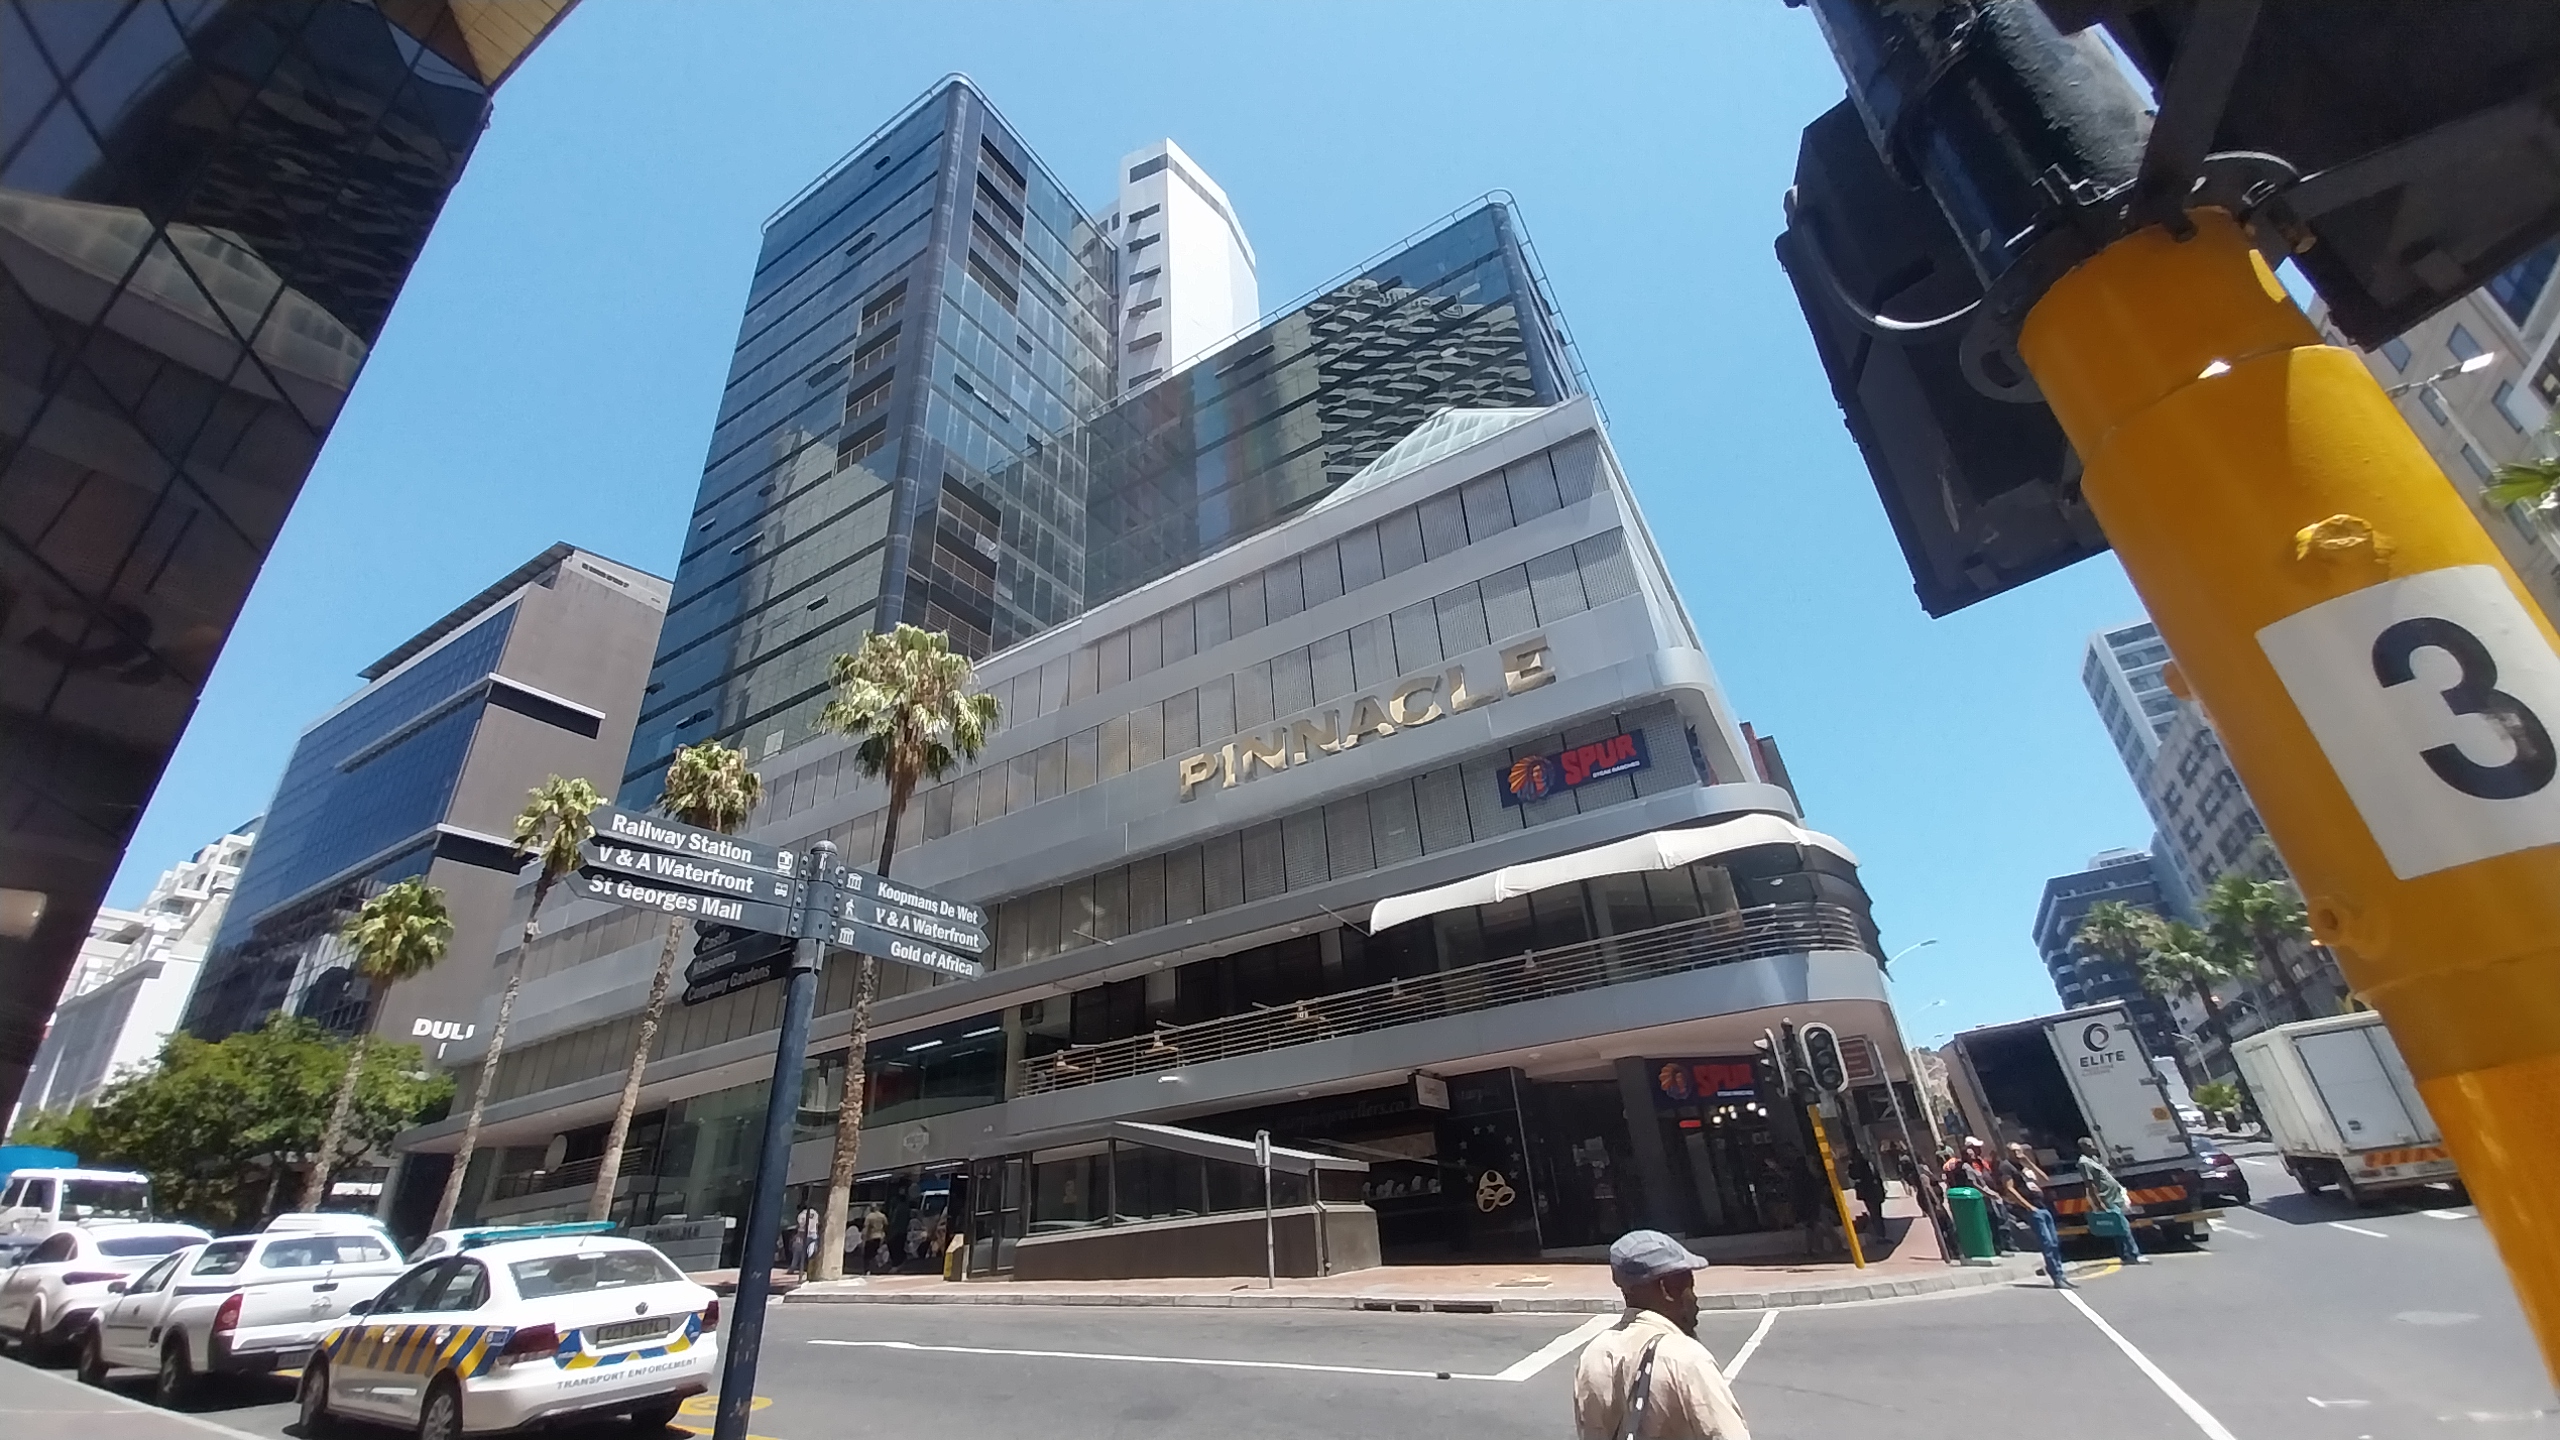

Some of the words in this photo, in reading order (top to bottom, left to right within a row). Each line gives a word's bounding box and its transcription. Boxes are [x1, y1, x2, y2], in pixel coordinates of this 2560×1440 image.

[1180, 634, 1556, 803] PINNACLE
[2372, 617, 2557, 800] 3
[1561, 733, 1637, 785] SPUR
[612, 814, 686, 849] Railway
[688, 833, 752, 863] Station
[599, 846, 613, 862] V
[615, 849, 633, 867] &
[636, 853, 651, 871] A
[657, 856, 754, 893] Waterfront
[589, 874, 612, 895] St
[617, 880, 697, 911] Georges
[701, 897, 743, 920] Mall
[878, 882, 939, 912] Koopmans
[940, 901, 955, 917] De
[957, 905, 978, 924] Wet
[876, 907, 886, 923] V
[887, 911, 899, 927] &
[900, 915, 910, 931] A
[913, 918, 979, 947] Waterfront
[730, 965, 771, 987] Gardens
[891, 941, 921, 961] Gold
[923, 951, 937, 966] of
[937, 954, 973, 976] Africa
[2080, 1050, 2125, 1068] ELITE
[557, 1370, 625, 1390] TRANSPORT
[628, 1357, 698, 1378] ENFORCEMENT
